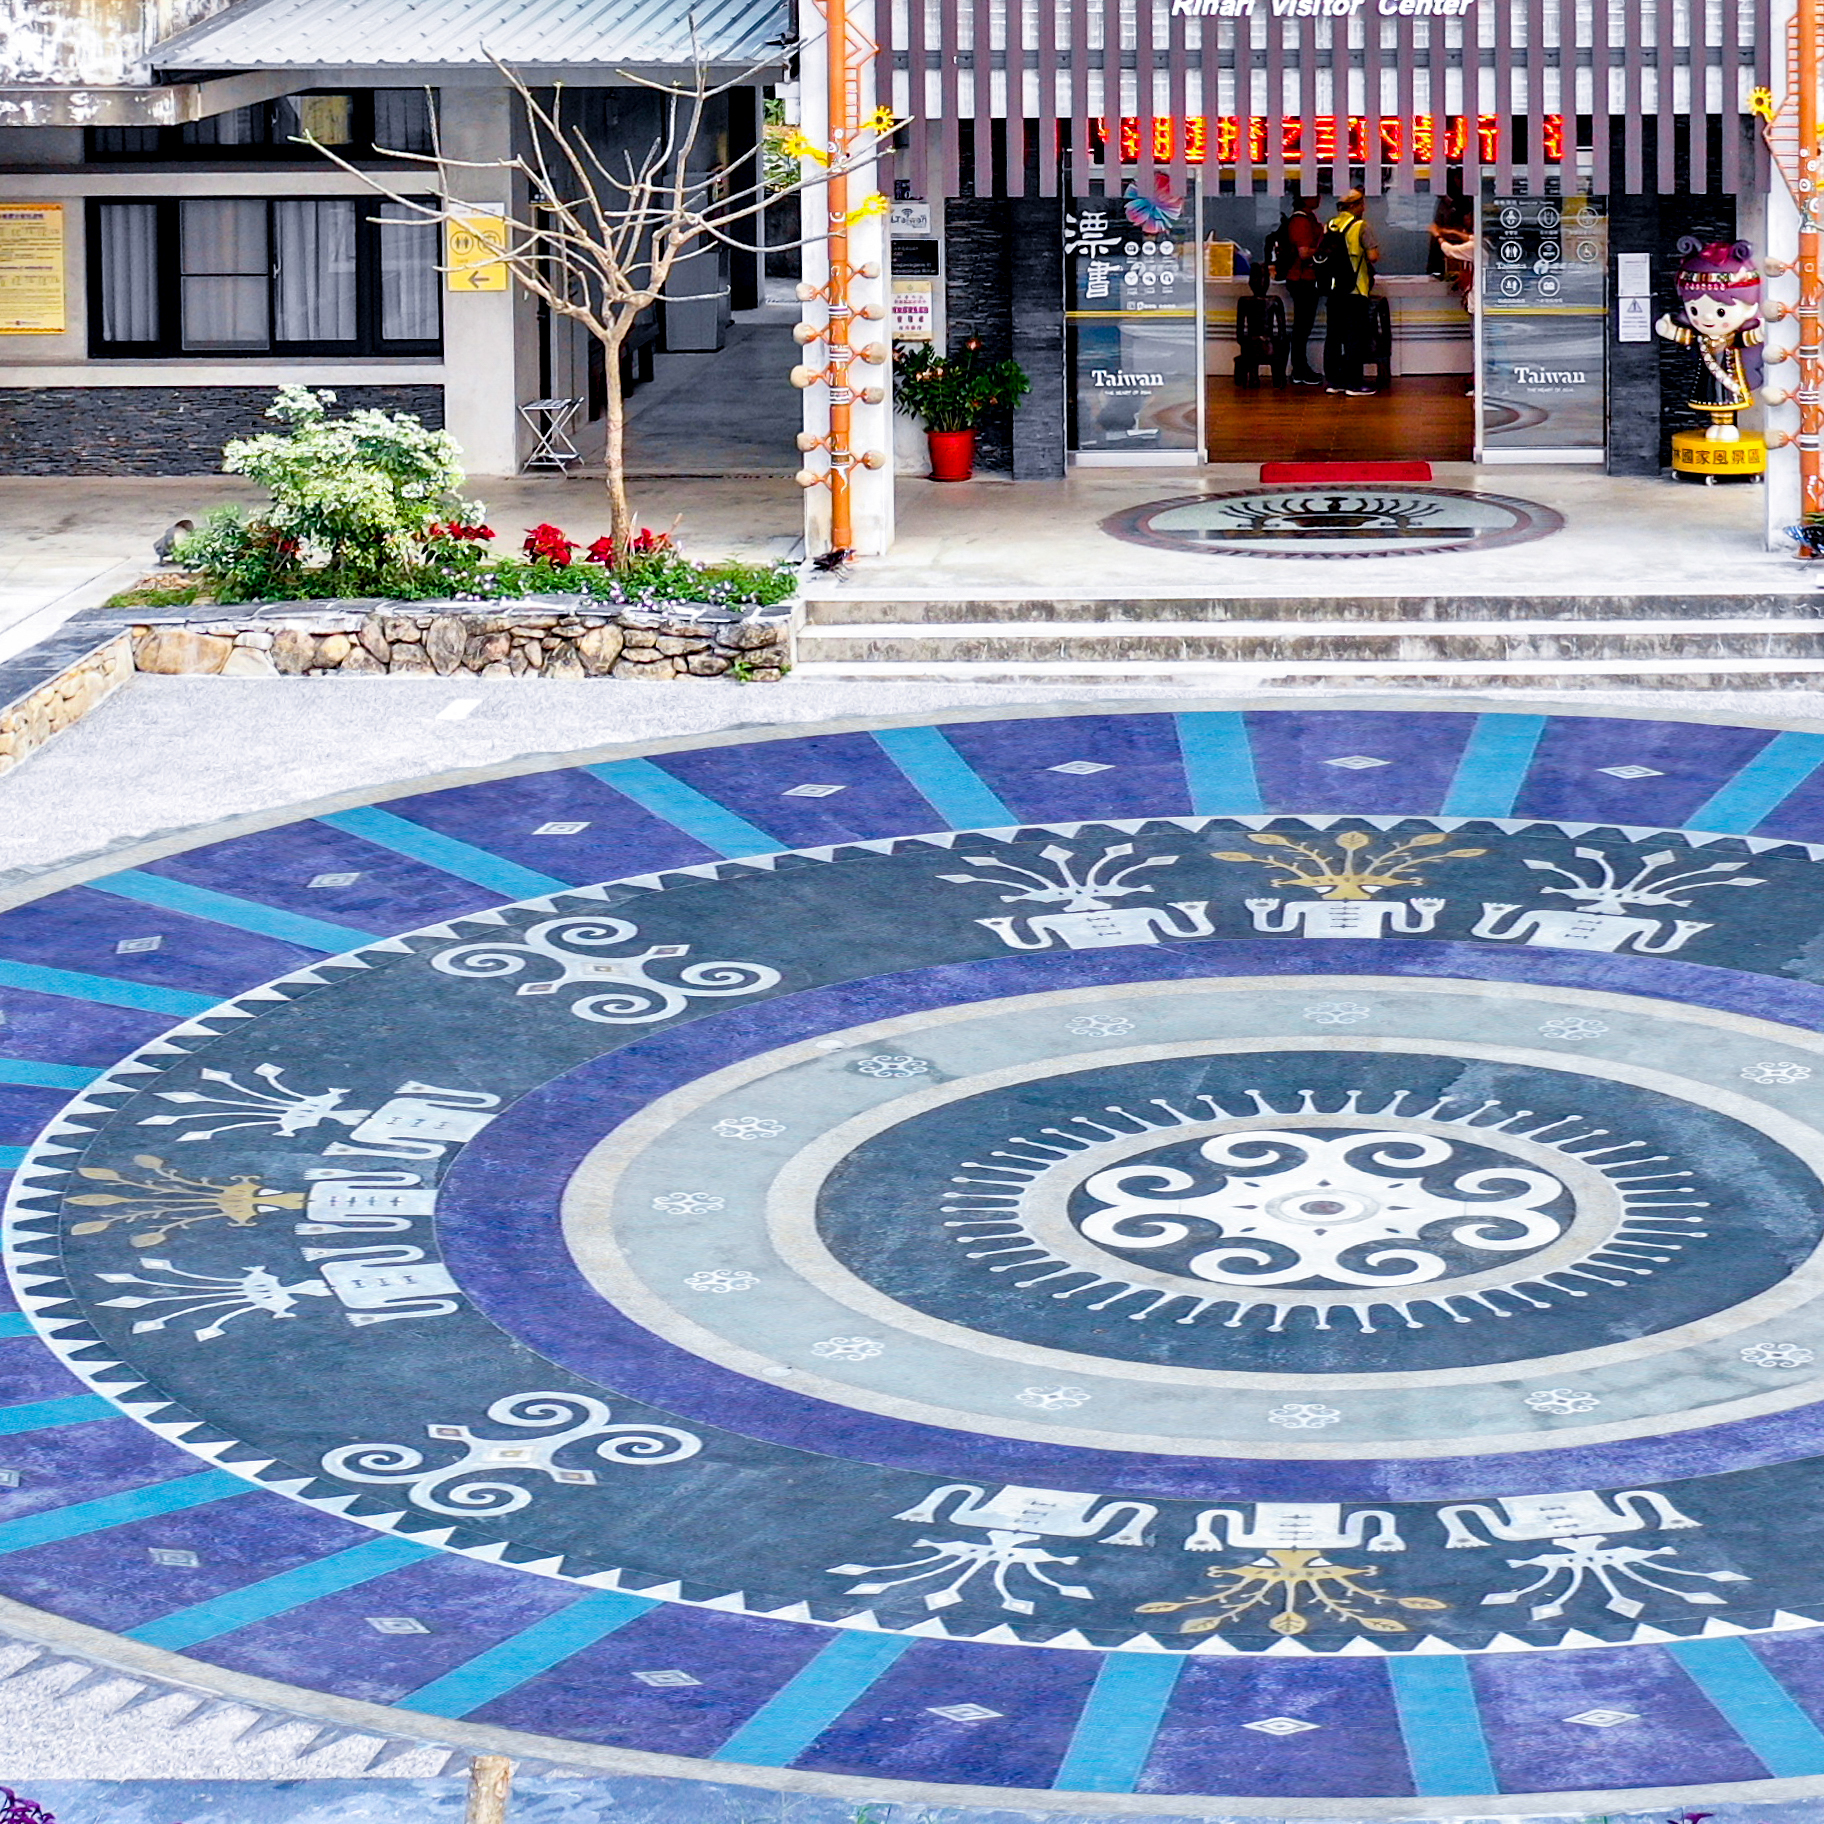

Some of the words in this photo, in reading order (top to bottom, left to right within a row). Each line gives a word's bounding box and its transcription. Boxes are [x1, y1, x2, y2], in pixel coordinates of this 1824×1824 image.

[1064, 210, 1123, 298] 漂書
[1092, 370, 1164, 387] Taiwan
[1514, 367, 1586, 384] Taiwan
